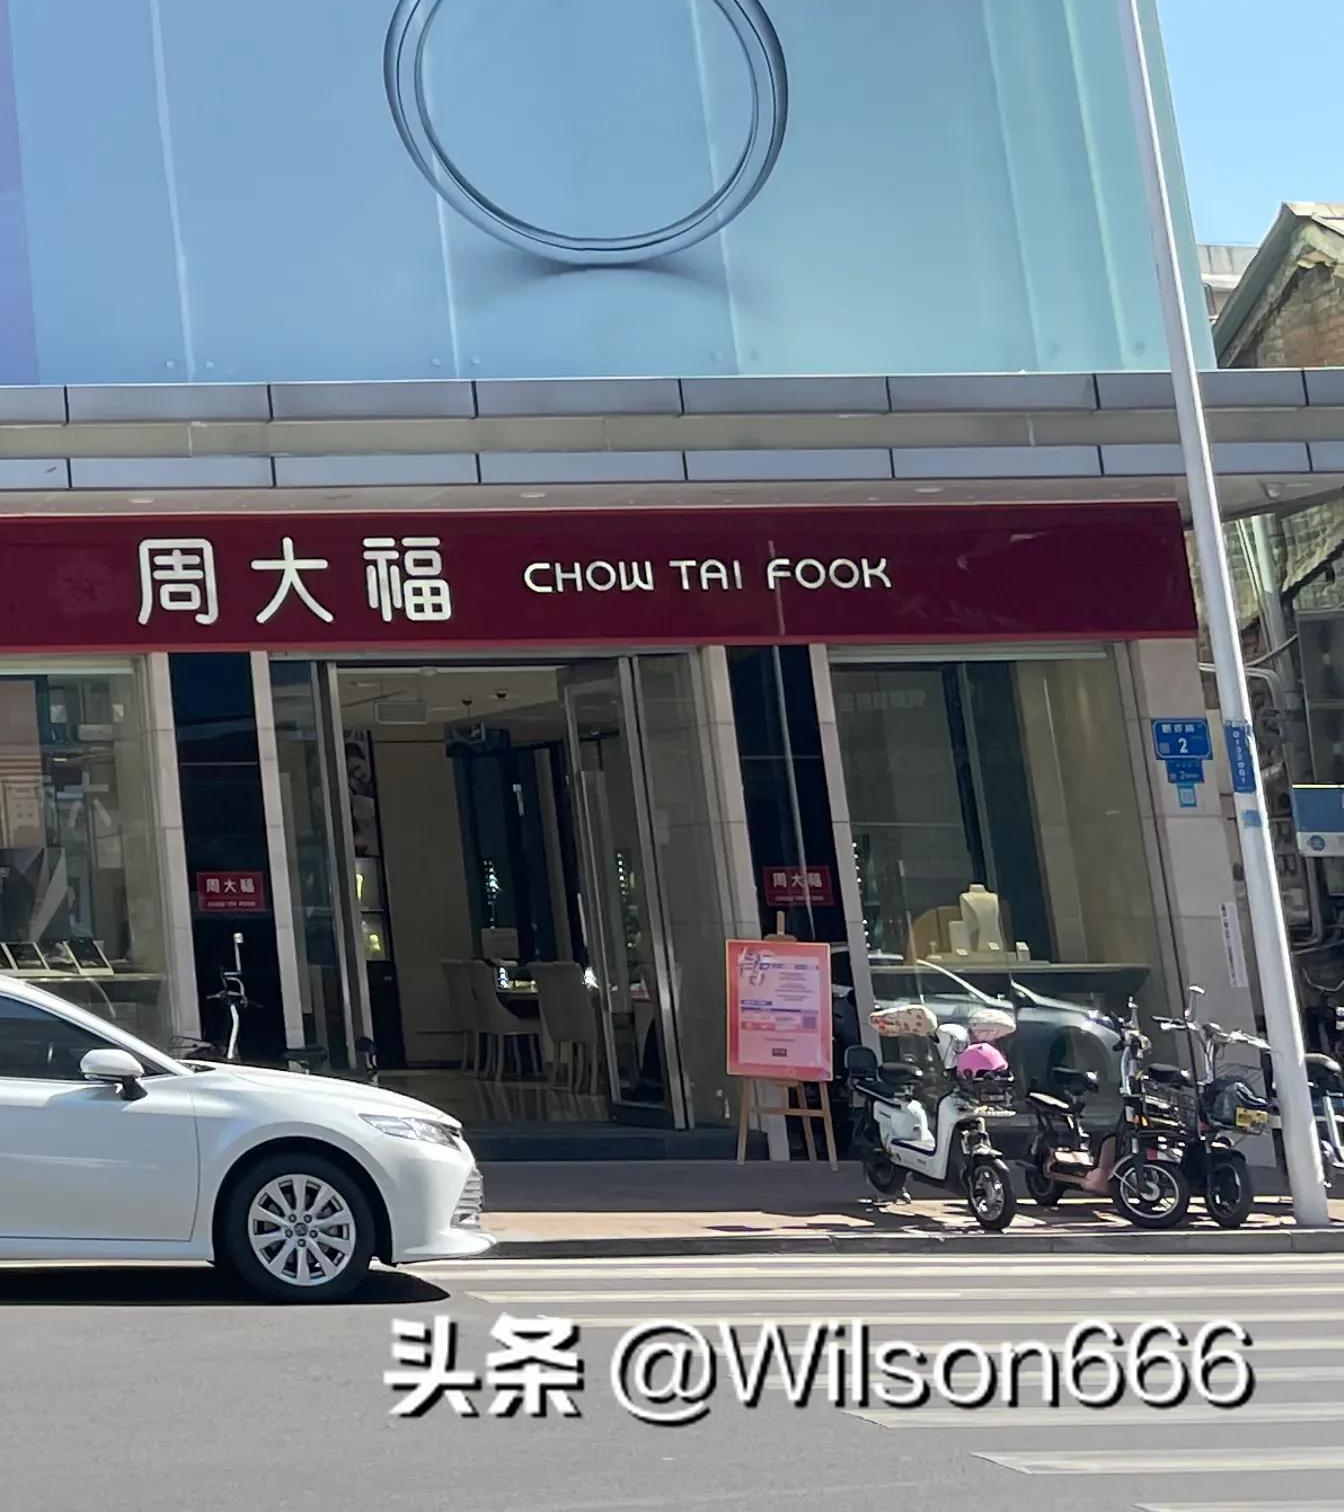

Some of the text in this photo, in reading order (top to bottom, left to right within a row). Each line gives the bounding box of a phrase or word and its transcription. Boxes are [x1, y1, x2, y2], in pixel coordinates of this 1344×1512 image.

[136, 536, 454, 626] 周大福
[523, 557, 892, 593] CHOW TAI FOOK
[1177, 737, 1189, 754] 2
